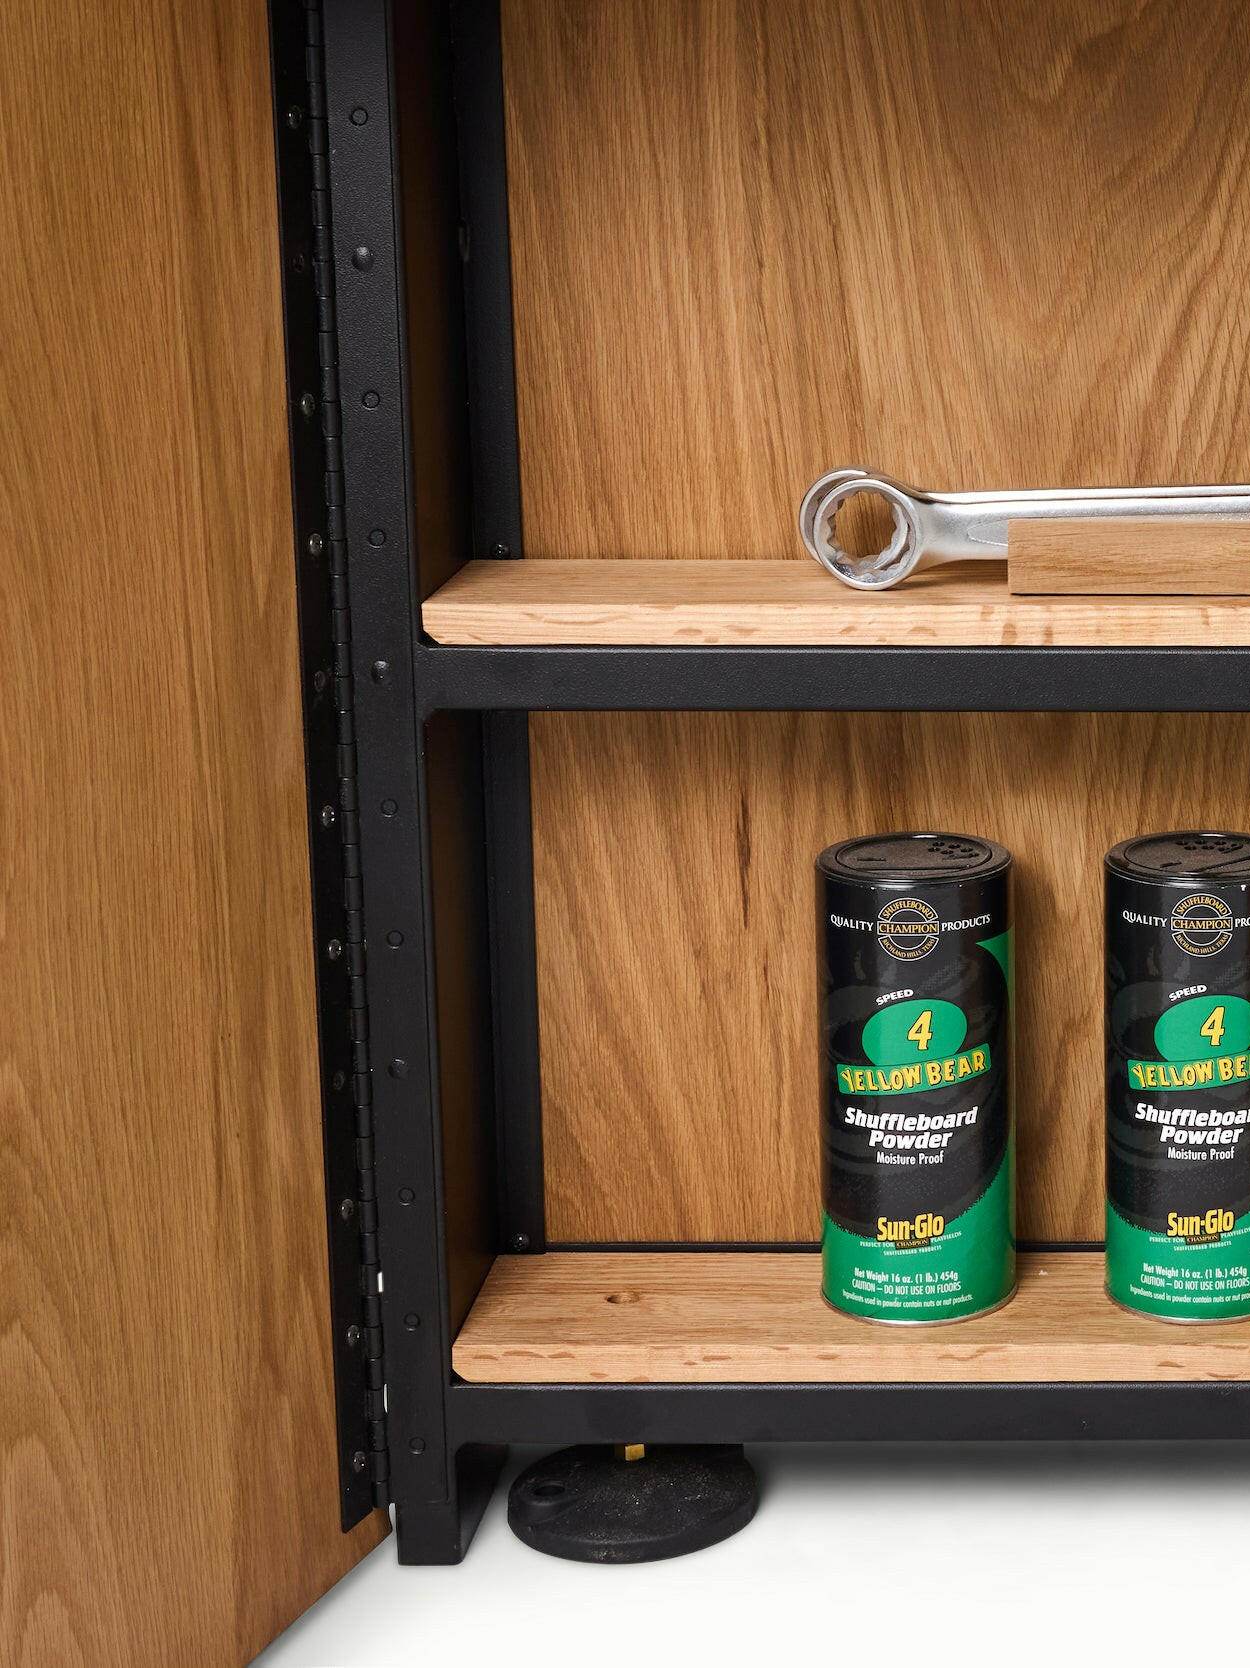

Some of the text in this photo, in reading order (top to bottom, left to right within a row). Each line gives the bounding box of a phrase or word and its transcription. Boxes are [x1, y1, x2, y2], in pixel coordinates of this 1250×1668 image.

[883, 901, 934, 919] SHUFFLEBOARD
[1176, 896, 1228, 915] SHUFFLEBOARD
[831, 914, 990, 934] QUALITY CHAMPION PRODUCTS
[1122, 910, 1168, 928] QUALITY
[1172, 919, 1230, 930] CHAMPION
[876, 989, 914, 1006] SPEED
[1168, 984, 1208, 1002] SPEED
[907, 1010, 933, 1050] 4
[1200, 1006, 1226, 1046] 4
[841, 1050, 986, 1093] YELLOW BEAR
[1132, 1059, 1214, 1088] YELLOW
[844, 1106, 978, 1132] Shuffleboard
[868, 1130, 954, 1150] Powder
[1160, 1125, 1244, 1144] Powder
[876, 1150, 944, 1165] Moisture Proof
[1168, 1146, 1234, 1160] Moisture Proof
[876, 1213, 944, 1241] Sun-Glo
[1166, 1208, 1234, 1236] Sun-Glo
[854, 1267, 864, 1278] Net
[866, 1270, 888, 1284] Weight
[891, 1274, 900, 1282] 16
[915, 1274, 922, 1284] (1
[926, 1273, 938, 1284] lb.)
[940, 1270, 958, 1281] 454g
[1143, 1262, 1154, 1273] Net
[1155, 1265, 1178, 1278] Weight
[1181, 1268, 1190, 1278] 16
[1205, 1268, 1212, 1278] (1
[1216, 1268, 1228, 1278] lb.)
[1229, 1266, 1248, 1277] 454g
[852, 1278, 876, 1292] CAUTION
[884, 1284, 894, 1294] DO
[896, 1285, 908, 1294] NOT
[910, 1286, 924, 1295] USE
[925, 1285, 935, 1294] ON
[937, 1282, 962, 1293] FLOORS
[1140, 1274, 1164, 1288] CAUTION
[1174, 1280, 1184, 1290] DO
[1186, 1280, 1198, 1290] NOT
[1200, 1280, 1214, 1290] USE
[1215, 1280, 1224, 1290] ON
[1226, 1277, 1250, 1289] FLOORS
[865, 1297, 876, 1306] used
[882, 1298, 902, 1308] powder
[1172, 1294, 1192, 1302] powder
